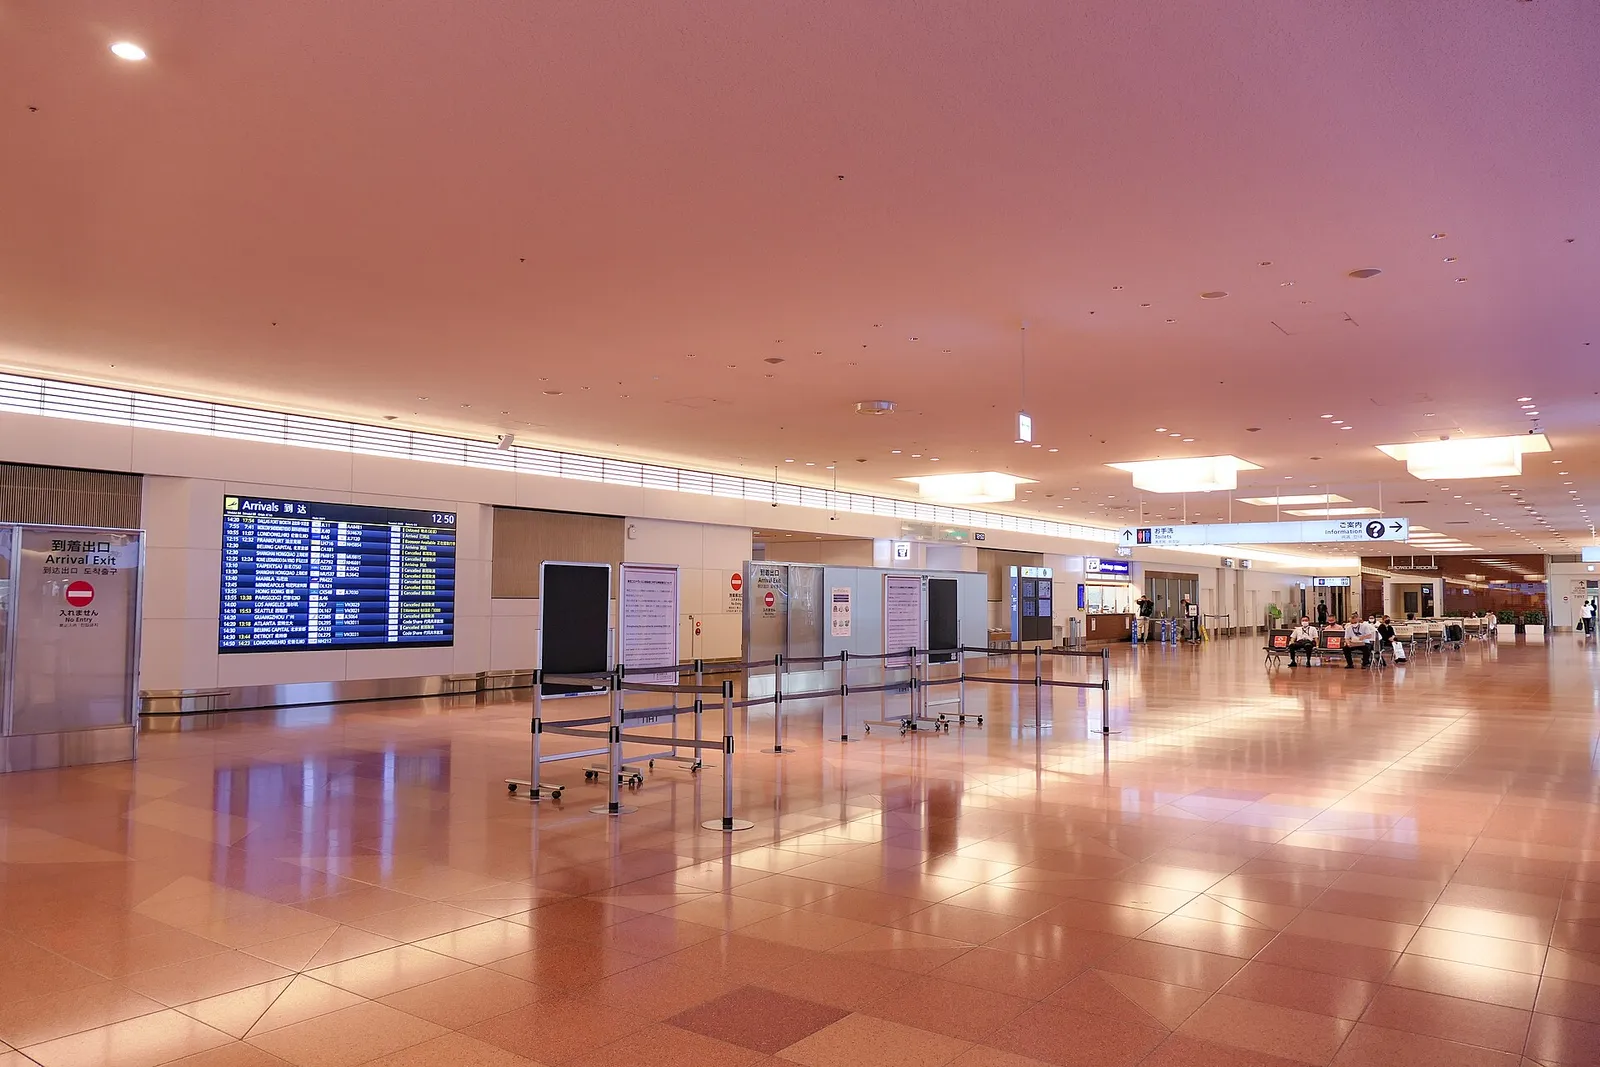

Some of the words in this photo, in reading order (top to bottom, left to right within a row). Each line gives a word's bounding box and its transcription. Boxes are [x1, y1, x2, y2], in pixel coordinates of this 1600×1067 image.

[242, 500, 279, 512] Arrivals
[51, 539, 110, 553] 到着出口
[45, 554, 88, 565] Arrival
[93, 555, 116, 566] Exit
[59, 609, 99, 617] 入れません
